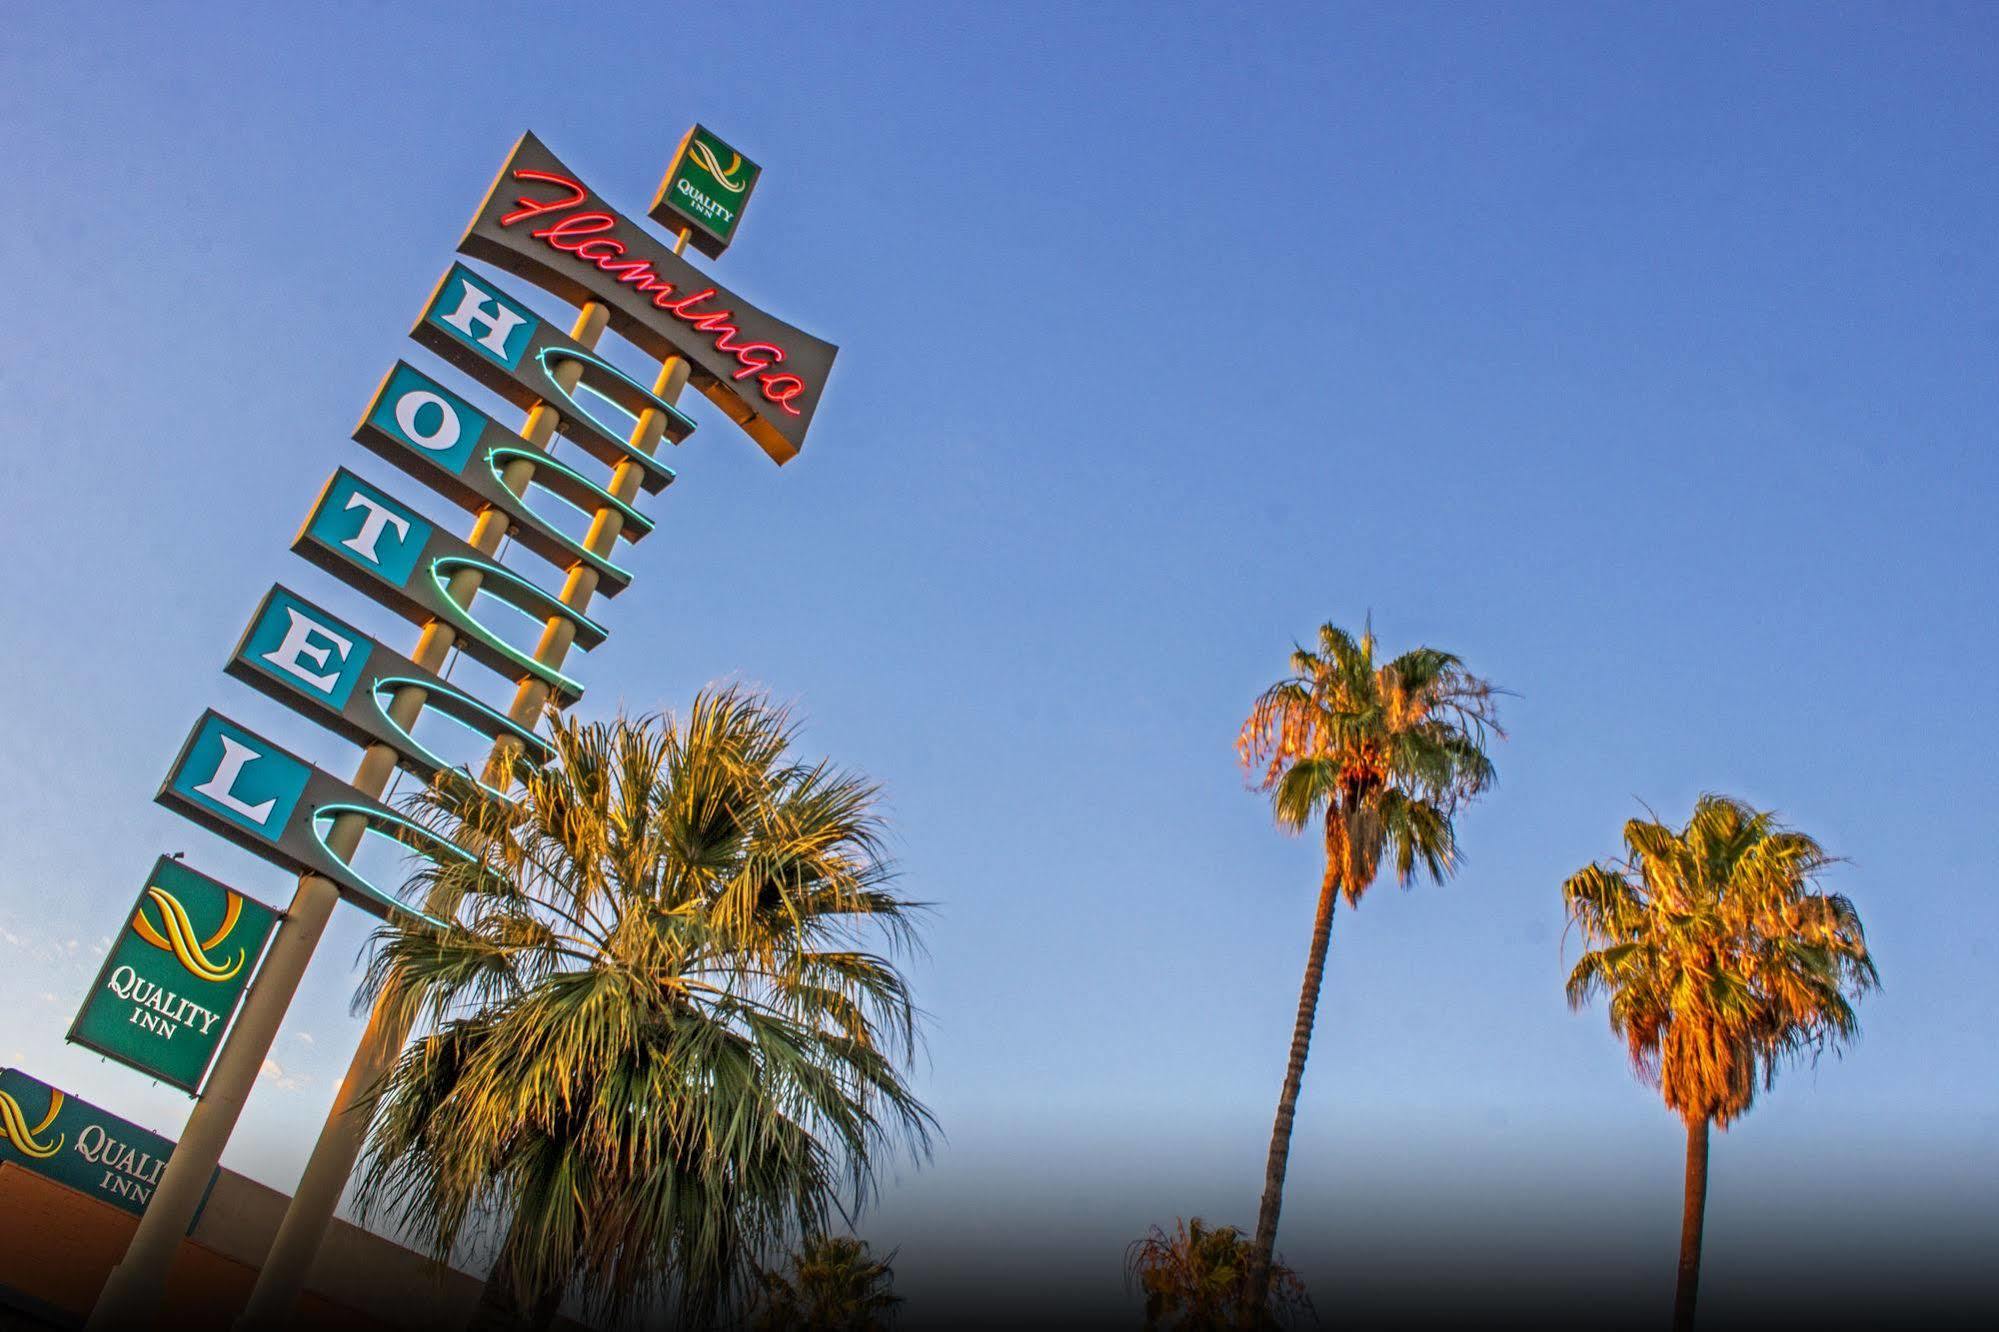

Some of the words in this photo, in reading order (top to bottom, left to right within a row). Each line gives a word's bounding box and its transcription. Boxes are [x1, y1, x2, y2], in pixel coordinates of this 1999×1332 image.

[677, 178, 735, 223] QUALITY
[690, 200, 713, 219] INN
[502, 168, 805, 416] Flamingo
[107, 965, 221, 1035] QUALITY
[129, 1007, 178, 1040] INN
[74, 1124, 168, 1186] QUALI
[100, 1170, 151, 1205] INN
